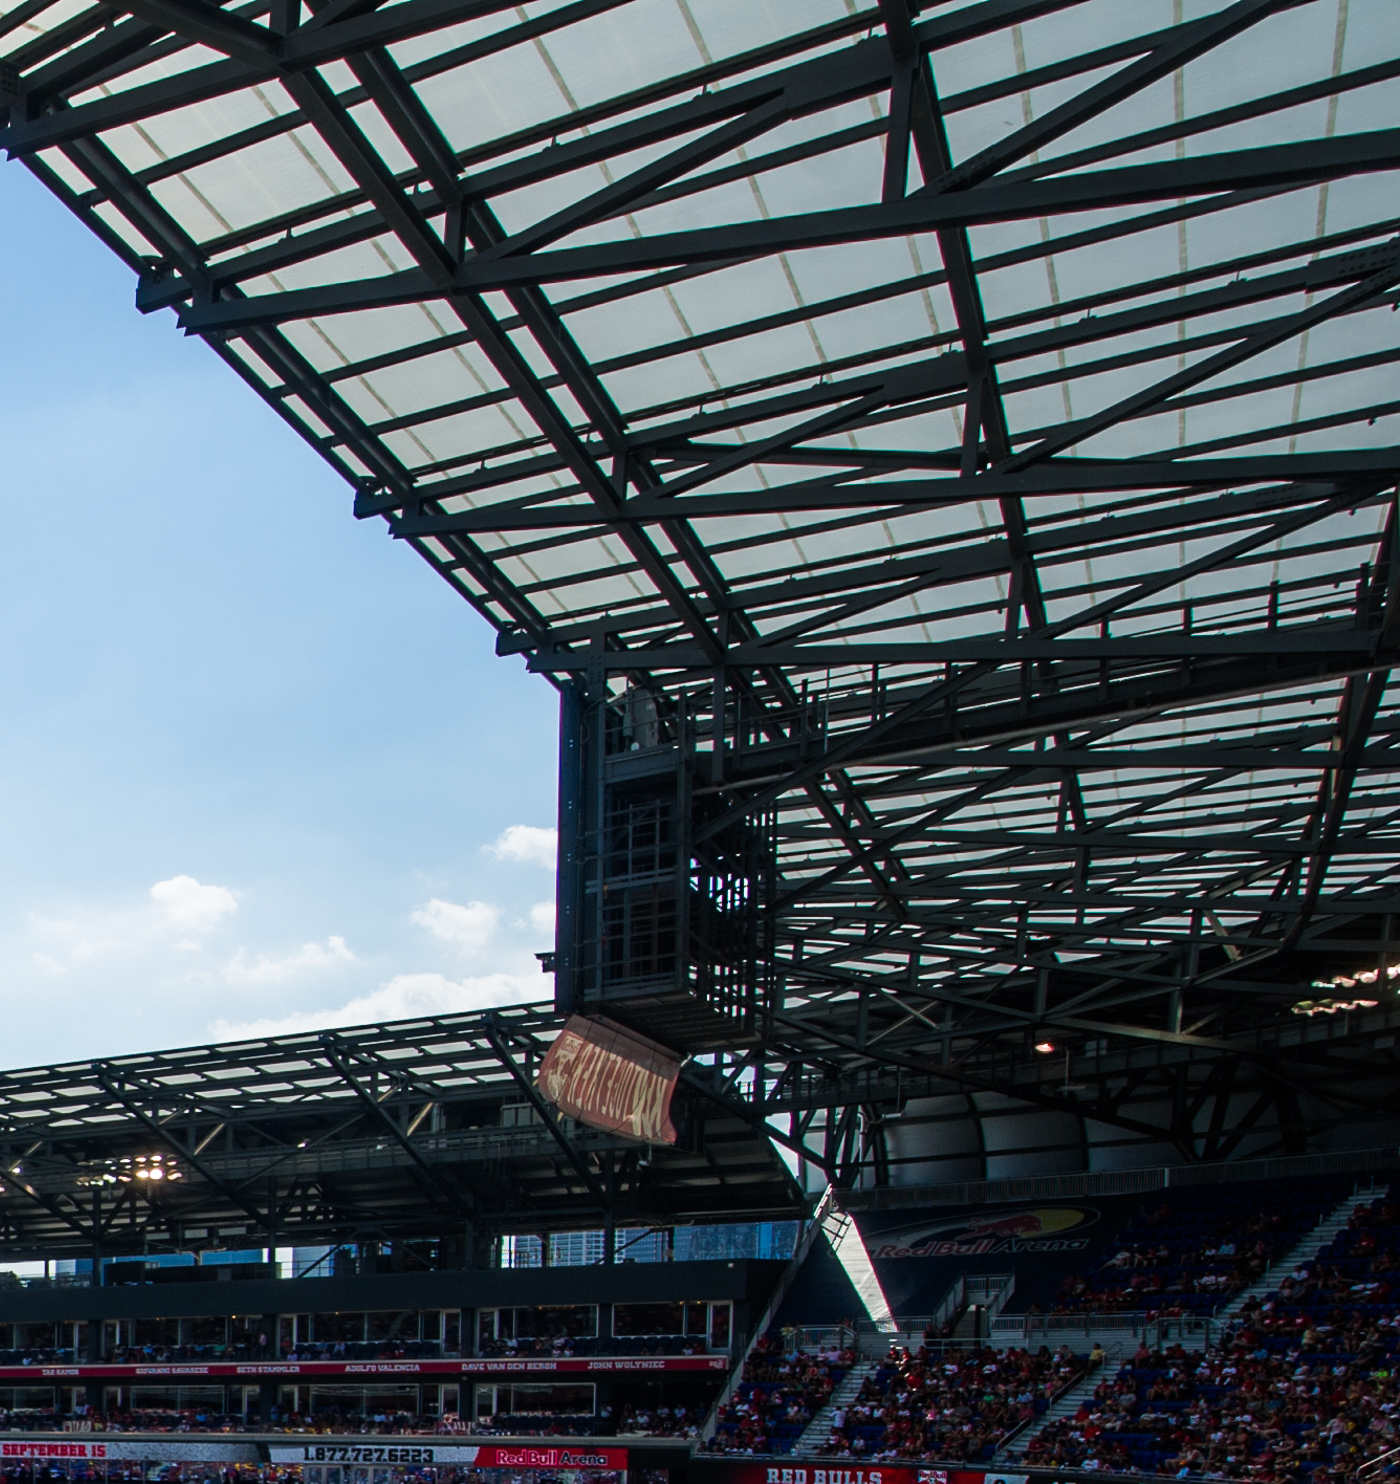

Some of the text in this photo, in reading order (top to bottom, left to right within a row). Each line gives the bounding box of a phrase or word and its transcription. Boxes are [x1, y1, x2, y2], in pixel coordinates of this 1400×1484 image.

[462, 1363, 486, 1371] DAVE
[587, 1362, 613, 1370] JOHN
[2, 1443, 87, 1457] SEPTEMBER
[91, 1445, 106, 1457] 15
[304, 1447, 435, 1463] 1.877.727.6223
[560, 1450, 608, 1466] Arena
[766, 1468, 807, 1484] RED
